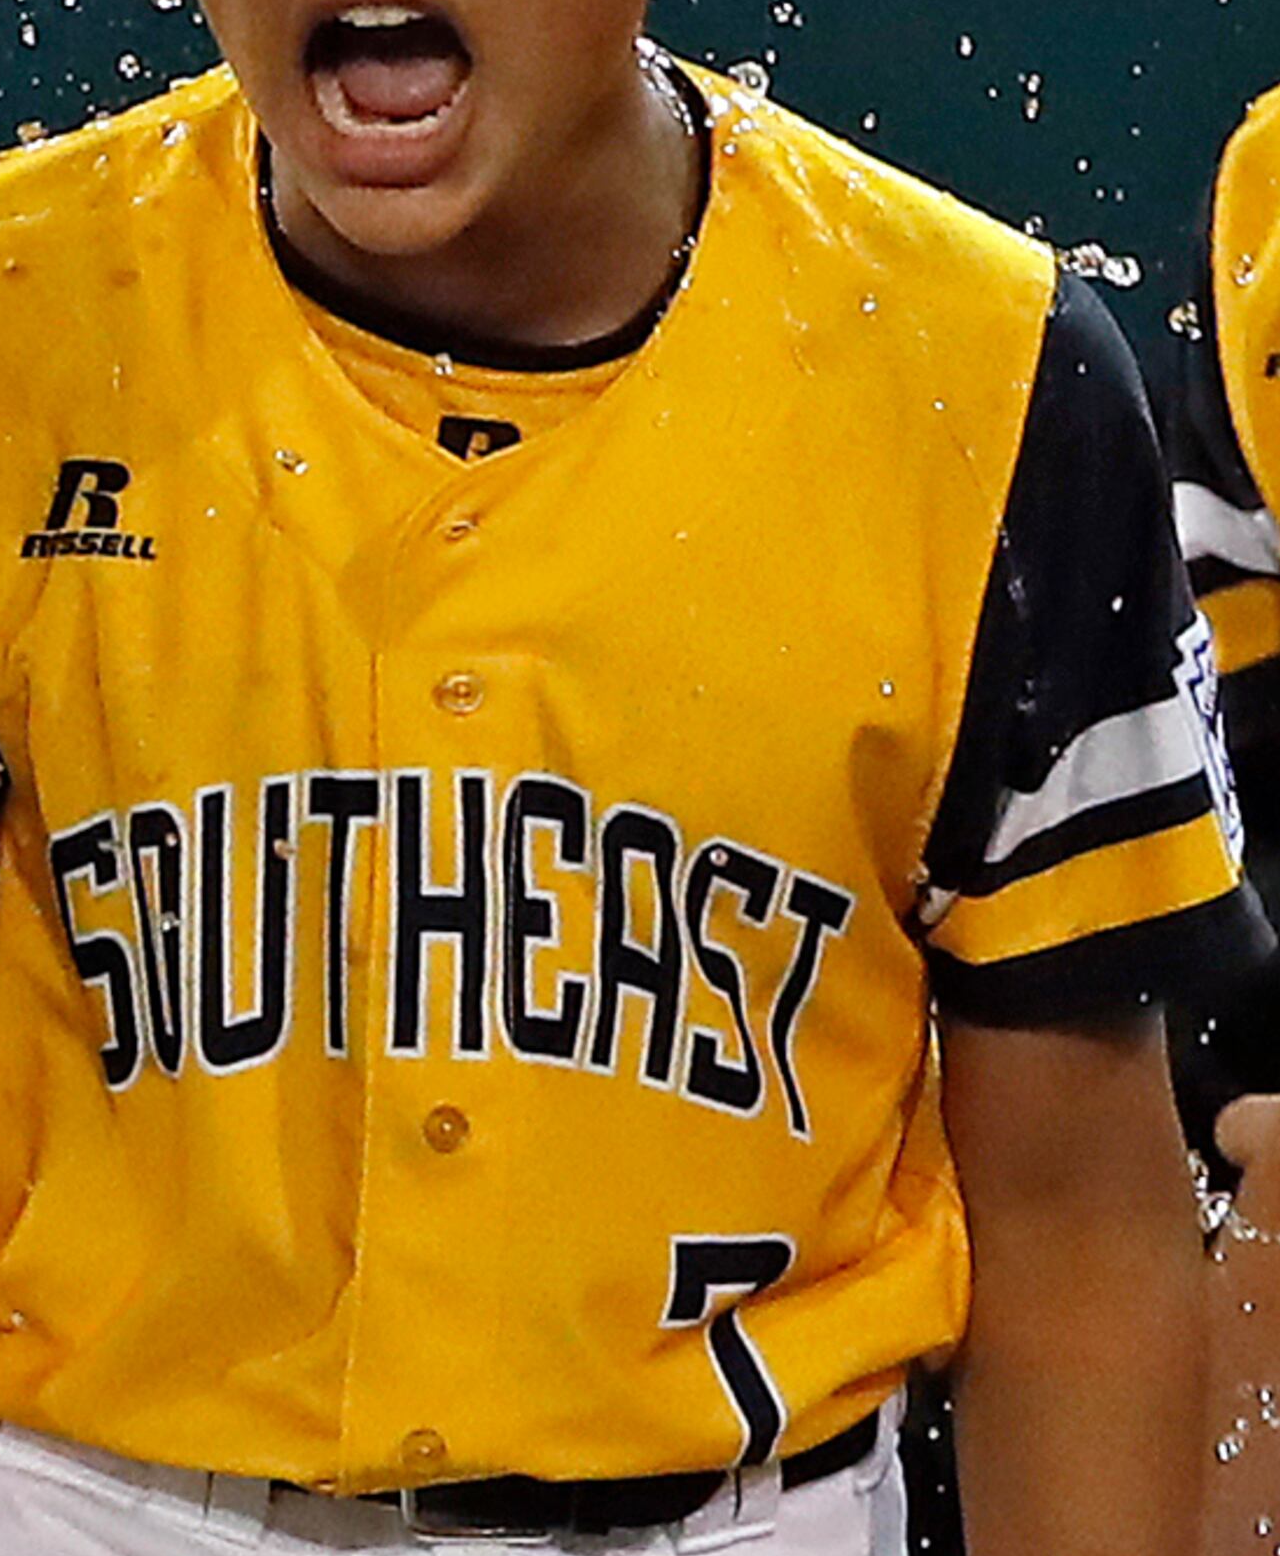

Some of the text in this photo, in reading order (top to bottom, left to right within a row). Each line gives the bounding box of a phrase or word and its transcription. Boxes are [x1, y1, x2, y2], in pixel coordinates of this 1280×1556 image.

[45, 459, 132, 529] R
[48, 767, 856, 1145] SOUTHEAST
[657, 1232, 797, 1470] 7
